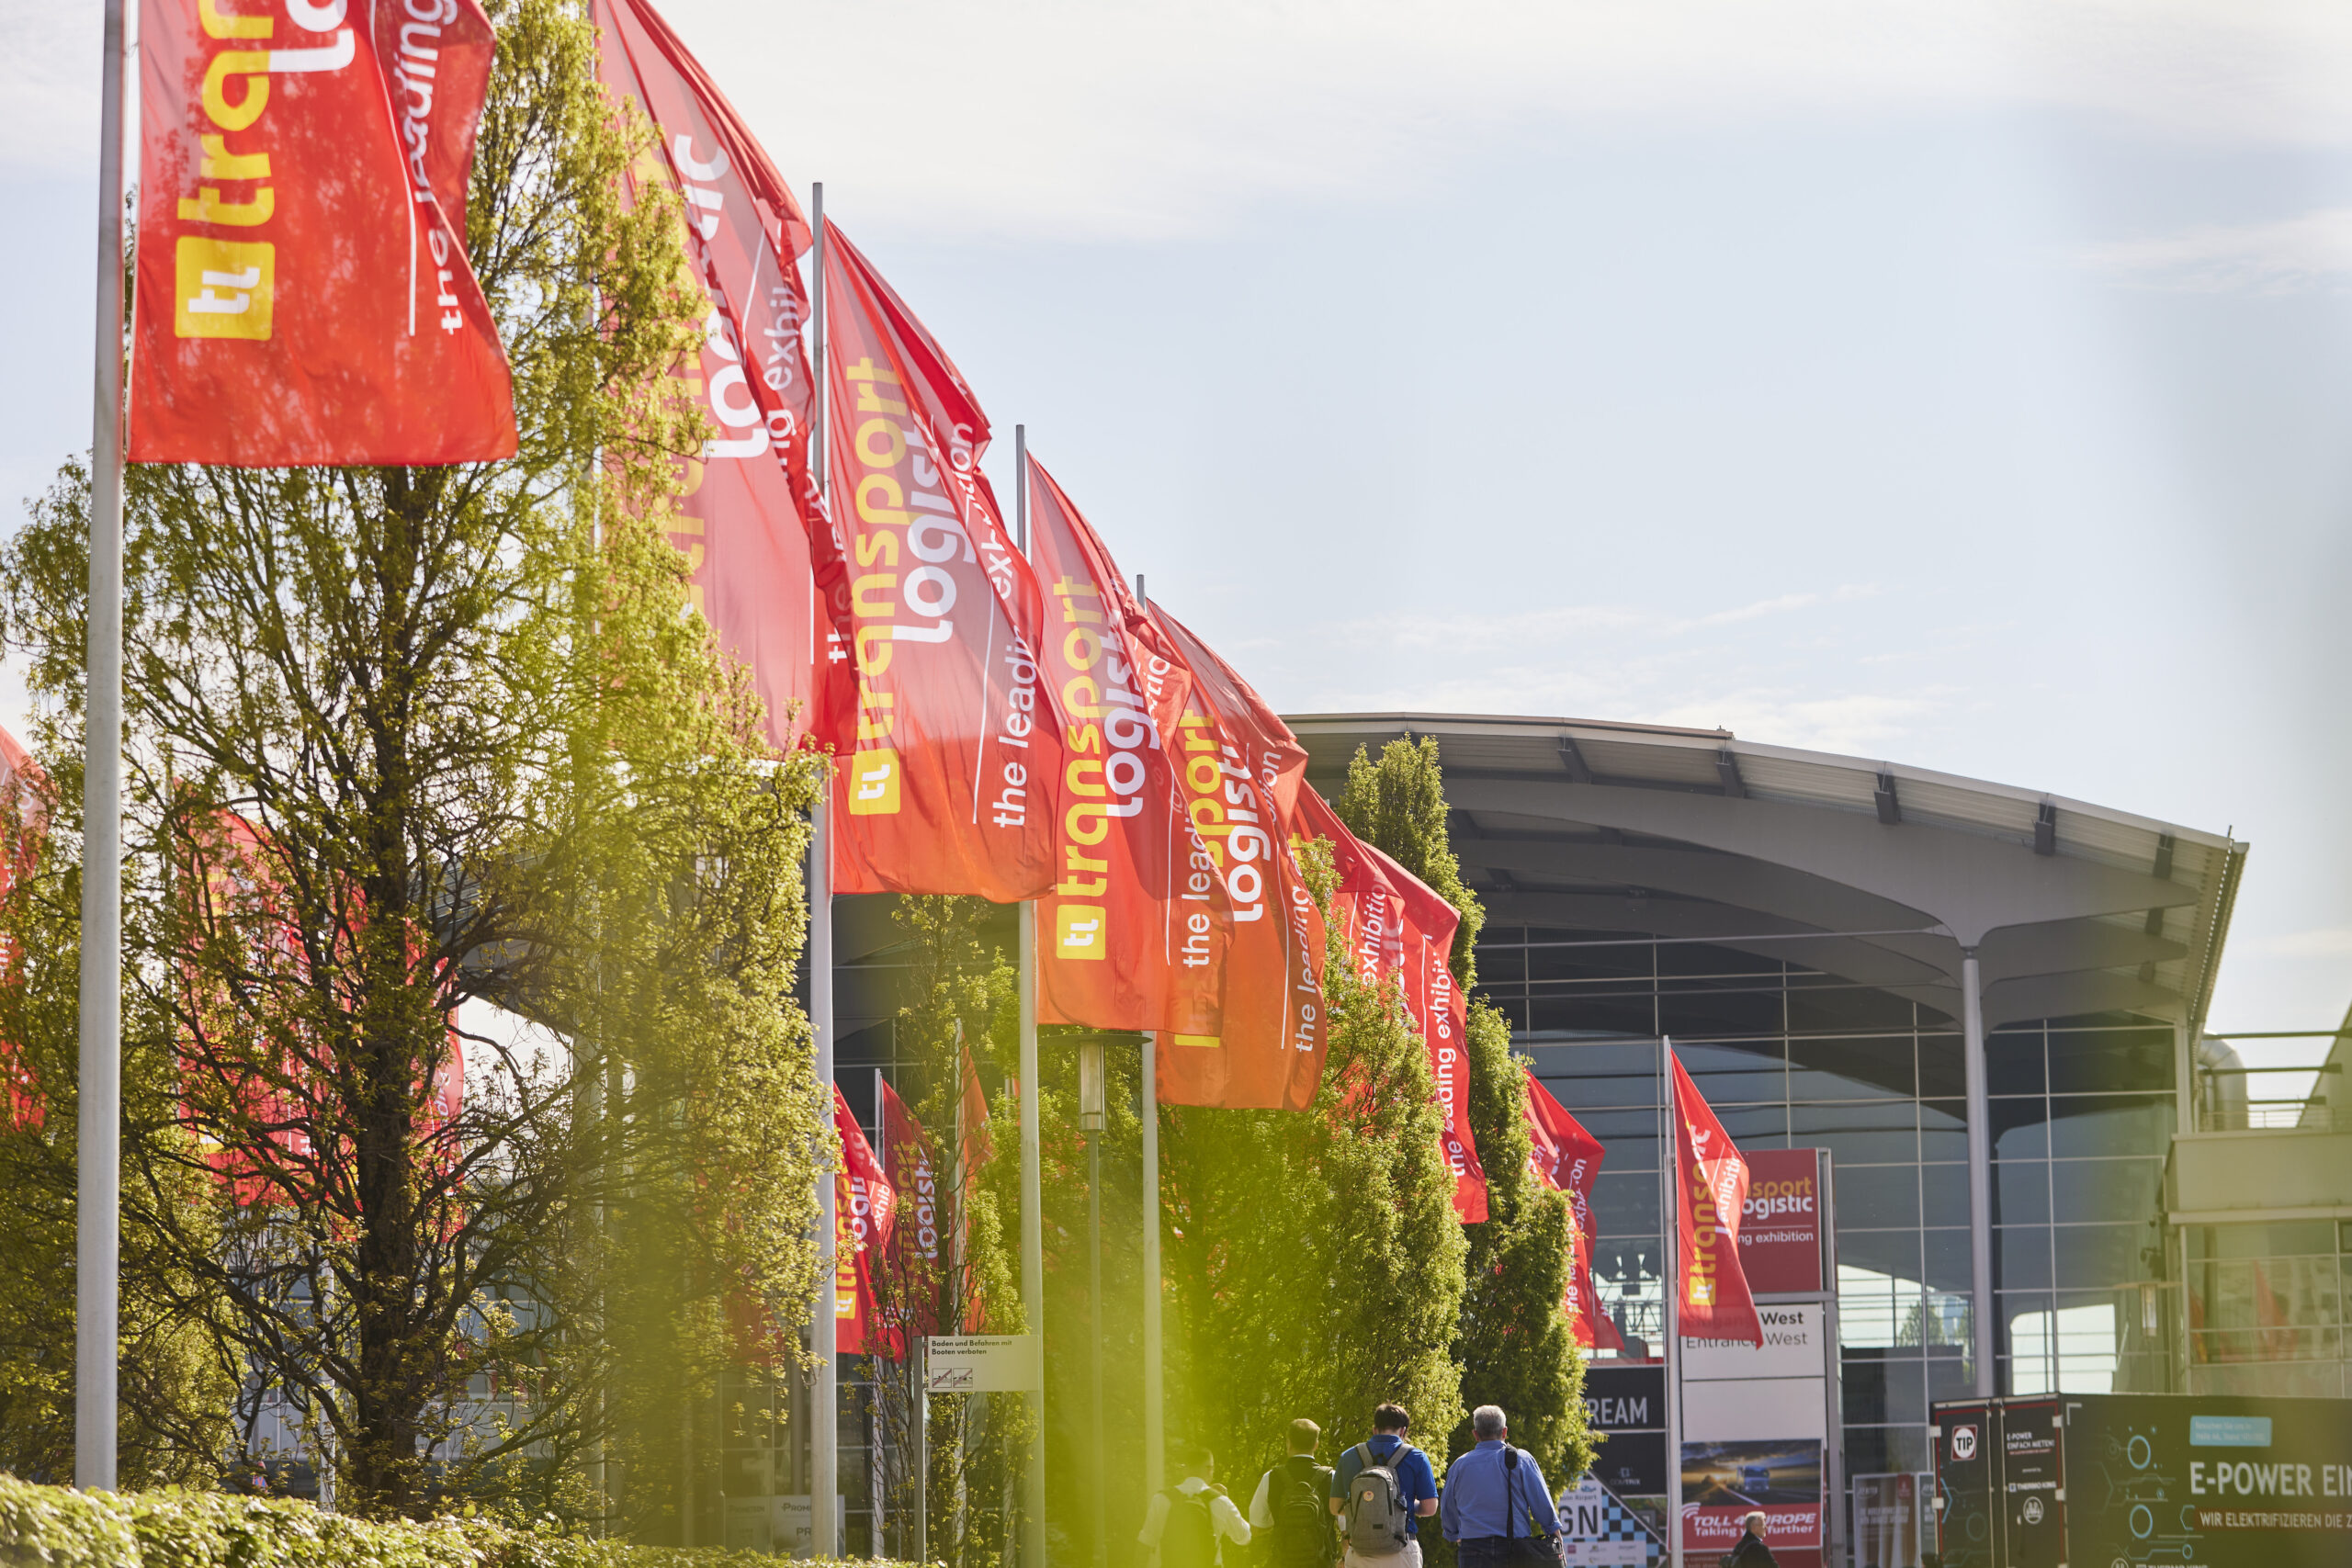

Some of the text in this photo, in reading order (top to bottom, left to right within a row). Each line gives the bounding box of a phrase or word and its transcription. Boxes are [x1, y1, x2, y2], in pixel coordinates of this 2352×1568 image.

[428, 229, 463, 335] the
[846, 357, 927, 740] transport
[1053, 575, 1113, 897] transport
[993, 762, 1030, 829] the
[1182, 913, 1210, 967] the
[1295, 1003, 1317, 1053] the
[1747, 1176, 1812, 1201] sport
[1756, 1231, 1814, 1243] exhibition
[1760, 1312, 1804, 1325] West
[1766, 1332, 1808, 1346] West
[1956, 1437, 1973, 1451] TIP
[2189, 1461, 2313, 1496] E-POWER
[1695, 1527, 1737, 1538] Taking
[1767, 1524, 1814, 1535] further
[1764, 1513, 1815, 1525] UROPE
[2200, 1512, 2223, 1528] WIR
[2225, 1512, 2322, 1529] ELEKTRIFIZIEREN
[2324, 1514, 2344, 1529] DIE
